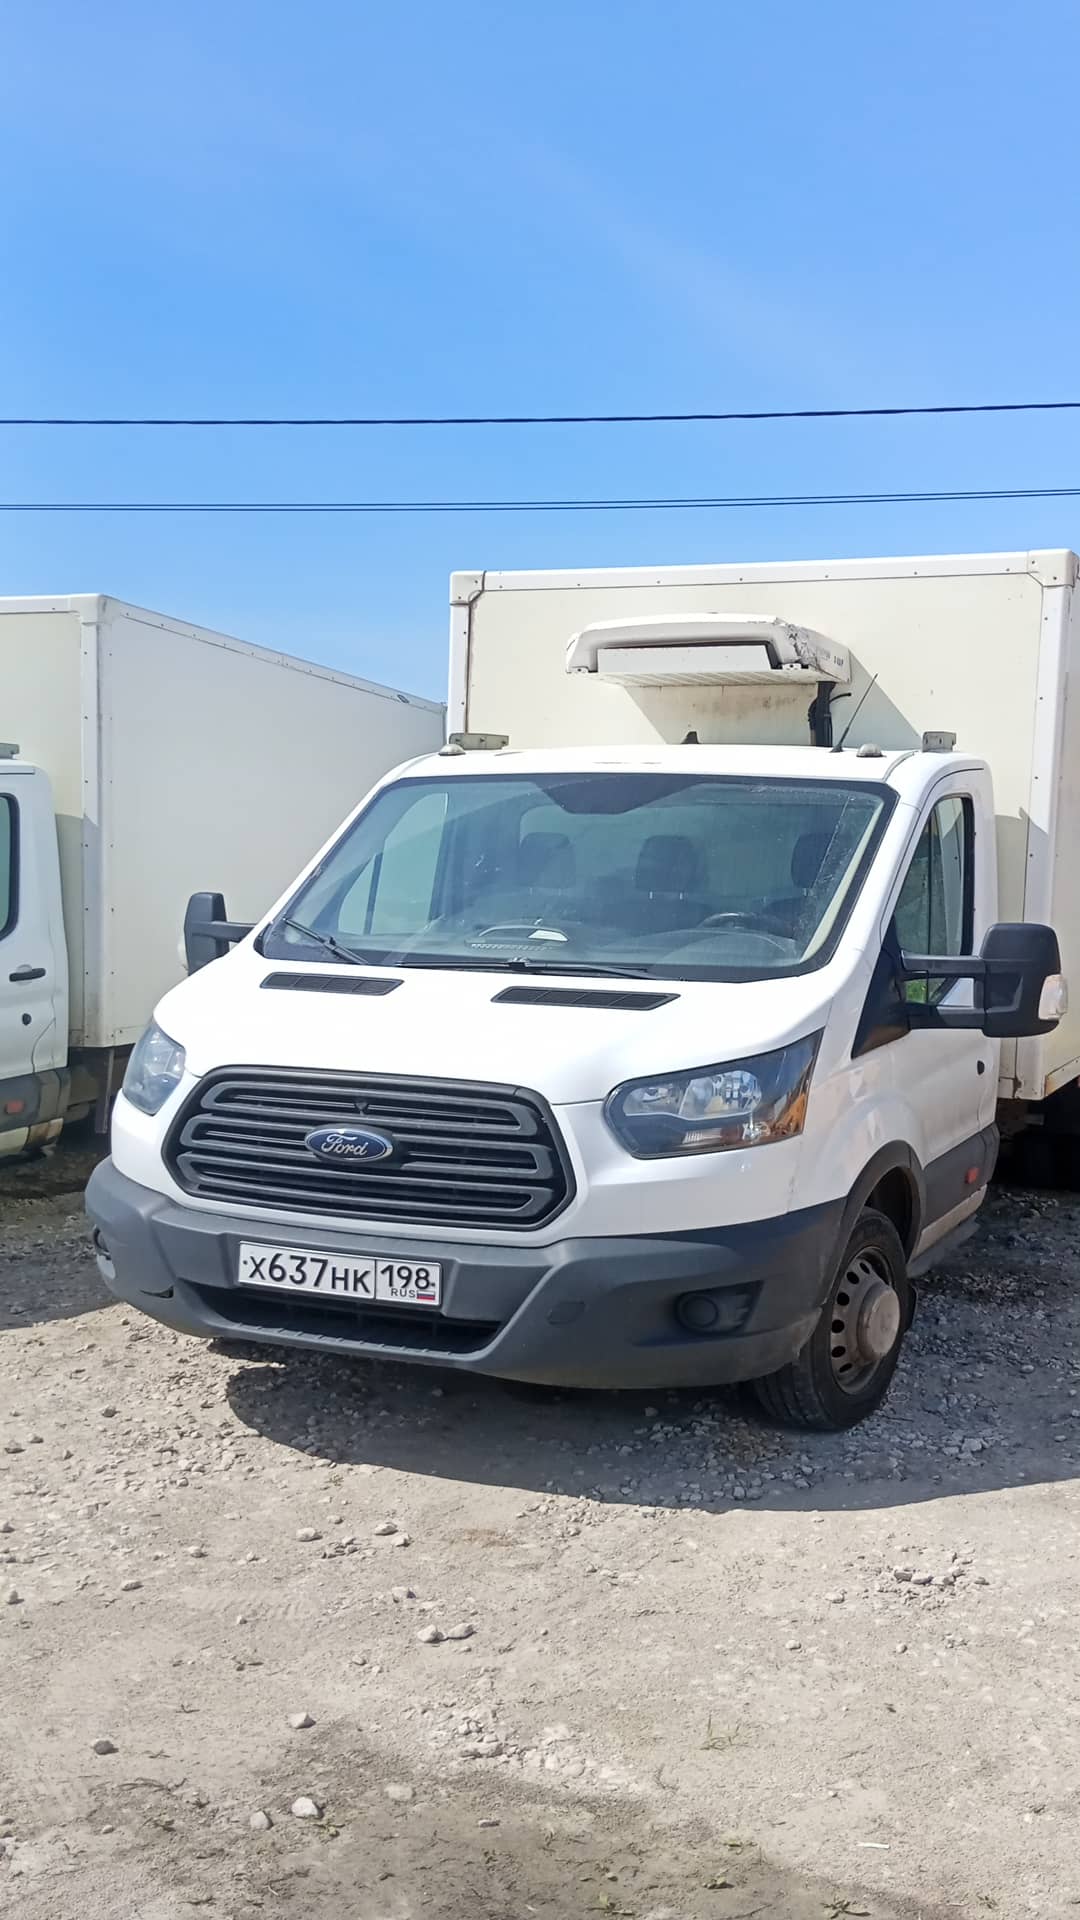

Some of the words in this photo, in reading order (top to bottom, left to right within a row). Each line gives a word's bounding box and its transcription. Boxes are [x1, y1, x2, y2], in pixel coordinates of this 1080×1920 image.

[321, 1133, 368, 1156] Ford
[249, 1253, 371, 1293] Х637НК
[380, 1264, 430, 1290] 198
[390, 1287, 416, 1298] RUS
